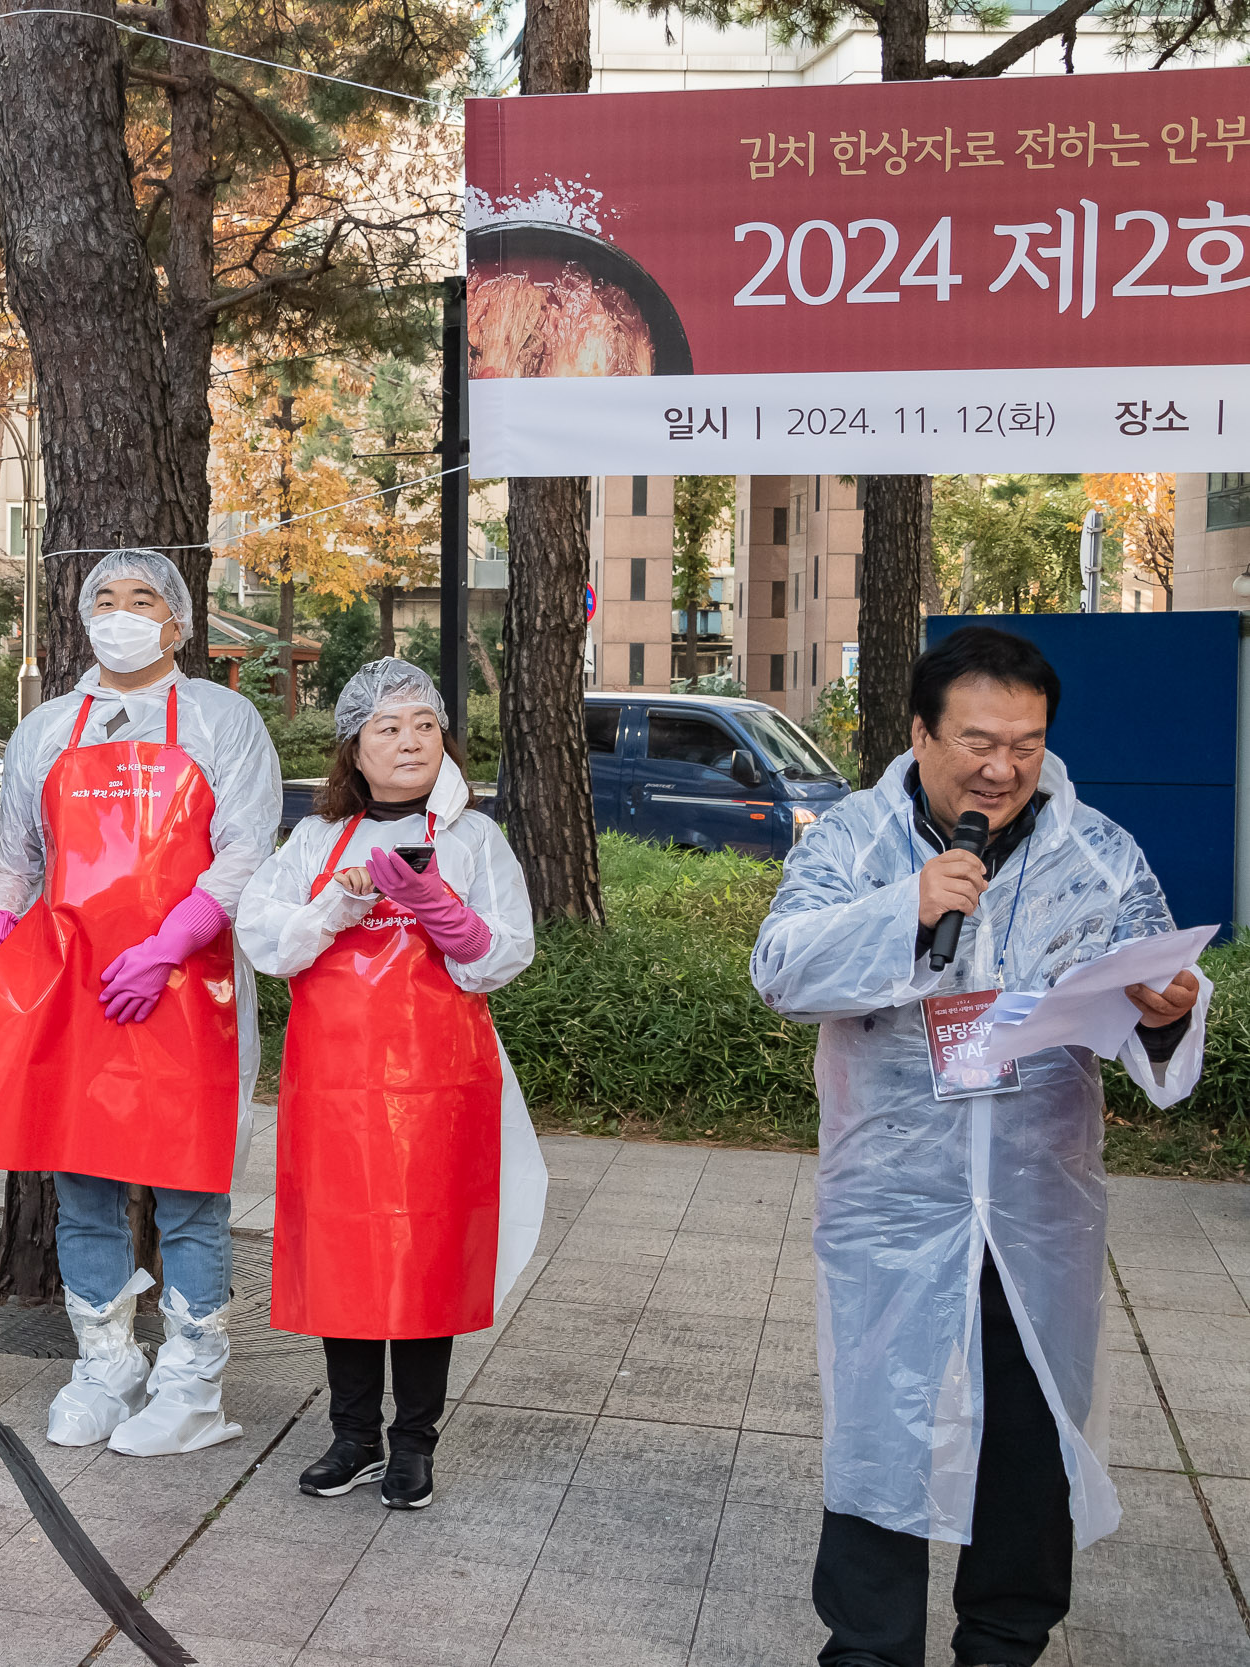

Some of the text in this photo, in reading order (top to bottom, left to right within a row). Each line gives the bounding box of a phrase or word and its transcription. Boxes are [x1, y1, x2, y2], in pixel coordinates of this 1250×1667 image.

[740, 131, 815, 180] 김치
[829, 126, 1005, 176] 한상자로
[1014, 120, 1150, 169] 전하는
[733, 216, 963, 306] 2024
[664, 406, 728, 440] 일시
[787, 407, 876, 435] 2024.
[894, 406, 938, 434] 11.
[956, 401, 1056, 437] 12(화)
[1114, 400, 1190, 436] 장소
